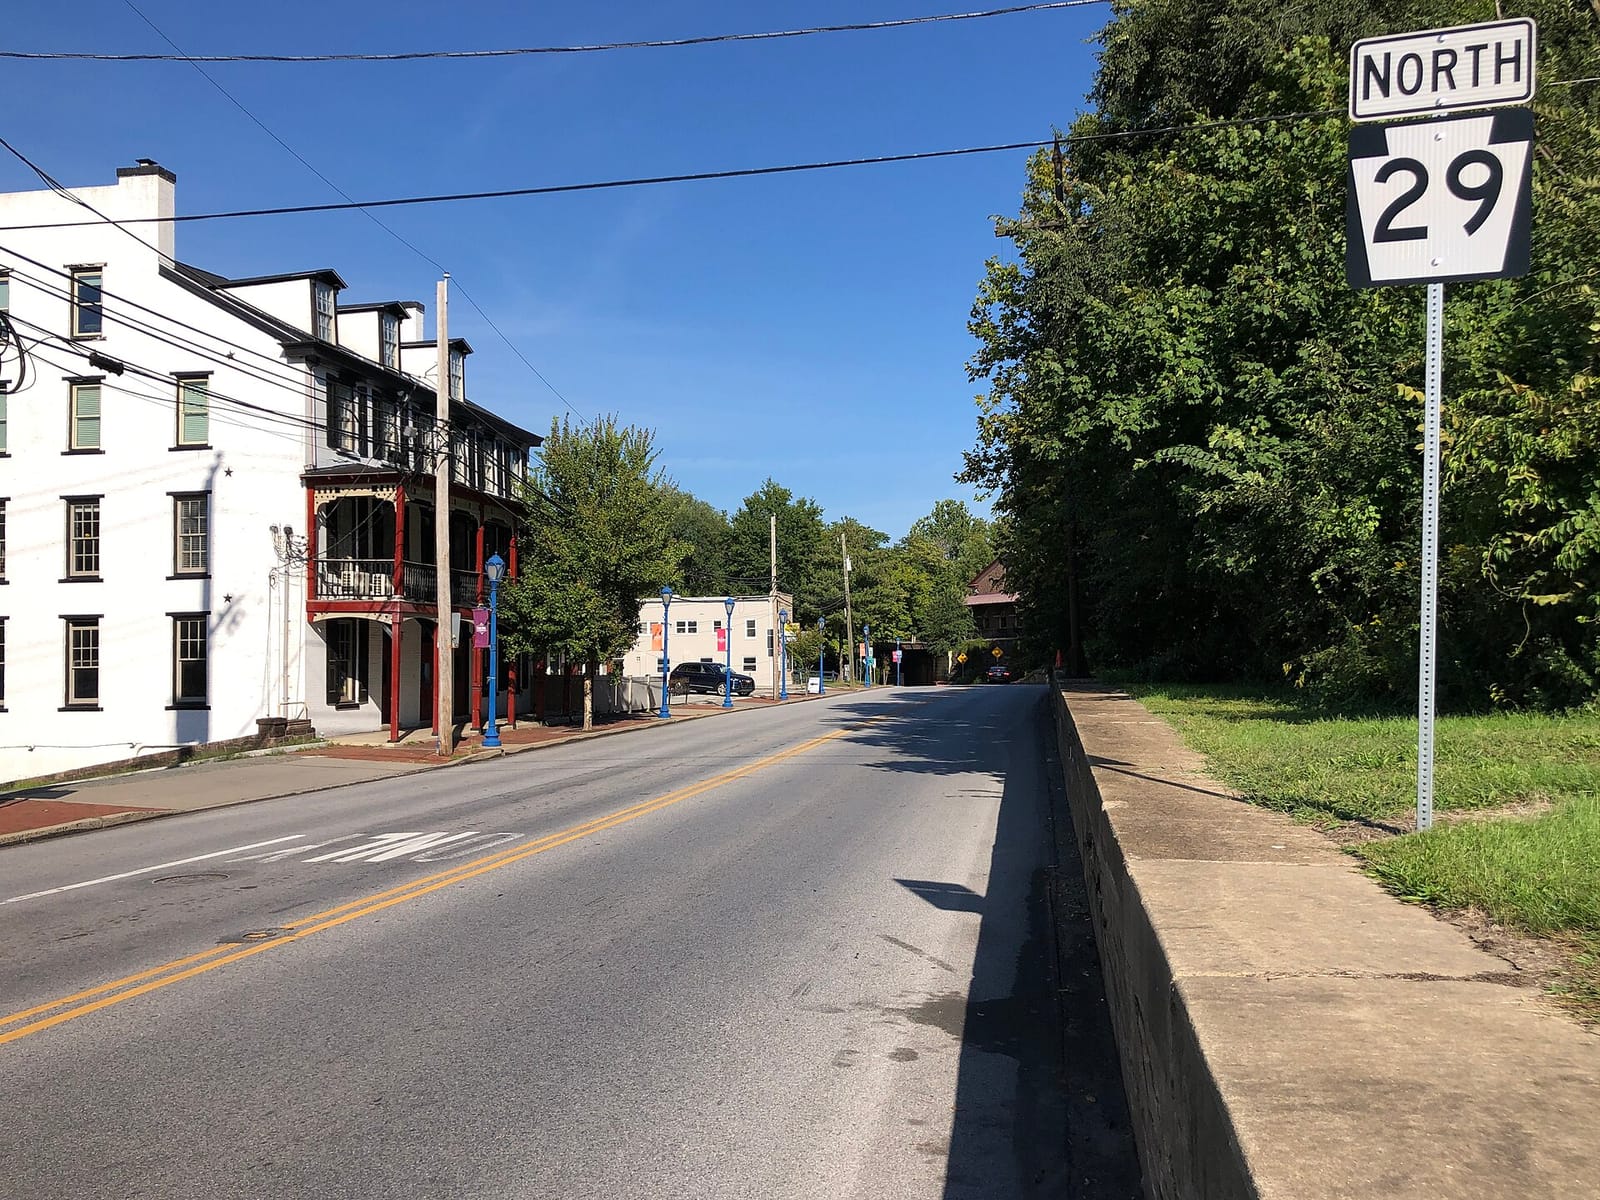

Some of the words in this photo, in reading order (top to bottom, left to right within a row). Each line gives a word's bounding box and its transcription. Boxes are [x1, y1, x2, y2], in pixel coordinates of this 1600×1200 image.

[1362, 39, 1522, 100] NORTH
[1373, 149, 1504, 244] 29
[224, 831, 525, 863] ONLY
